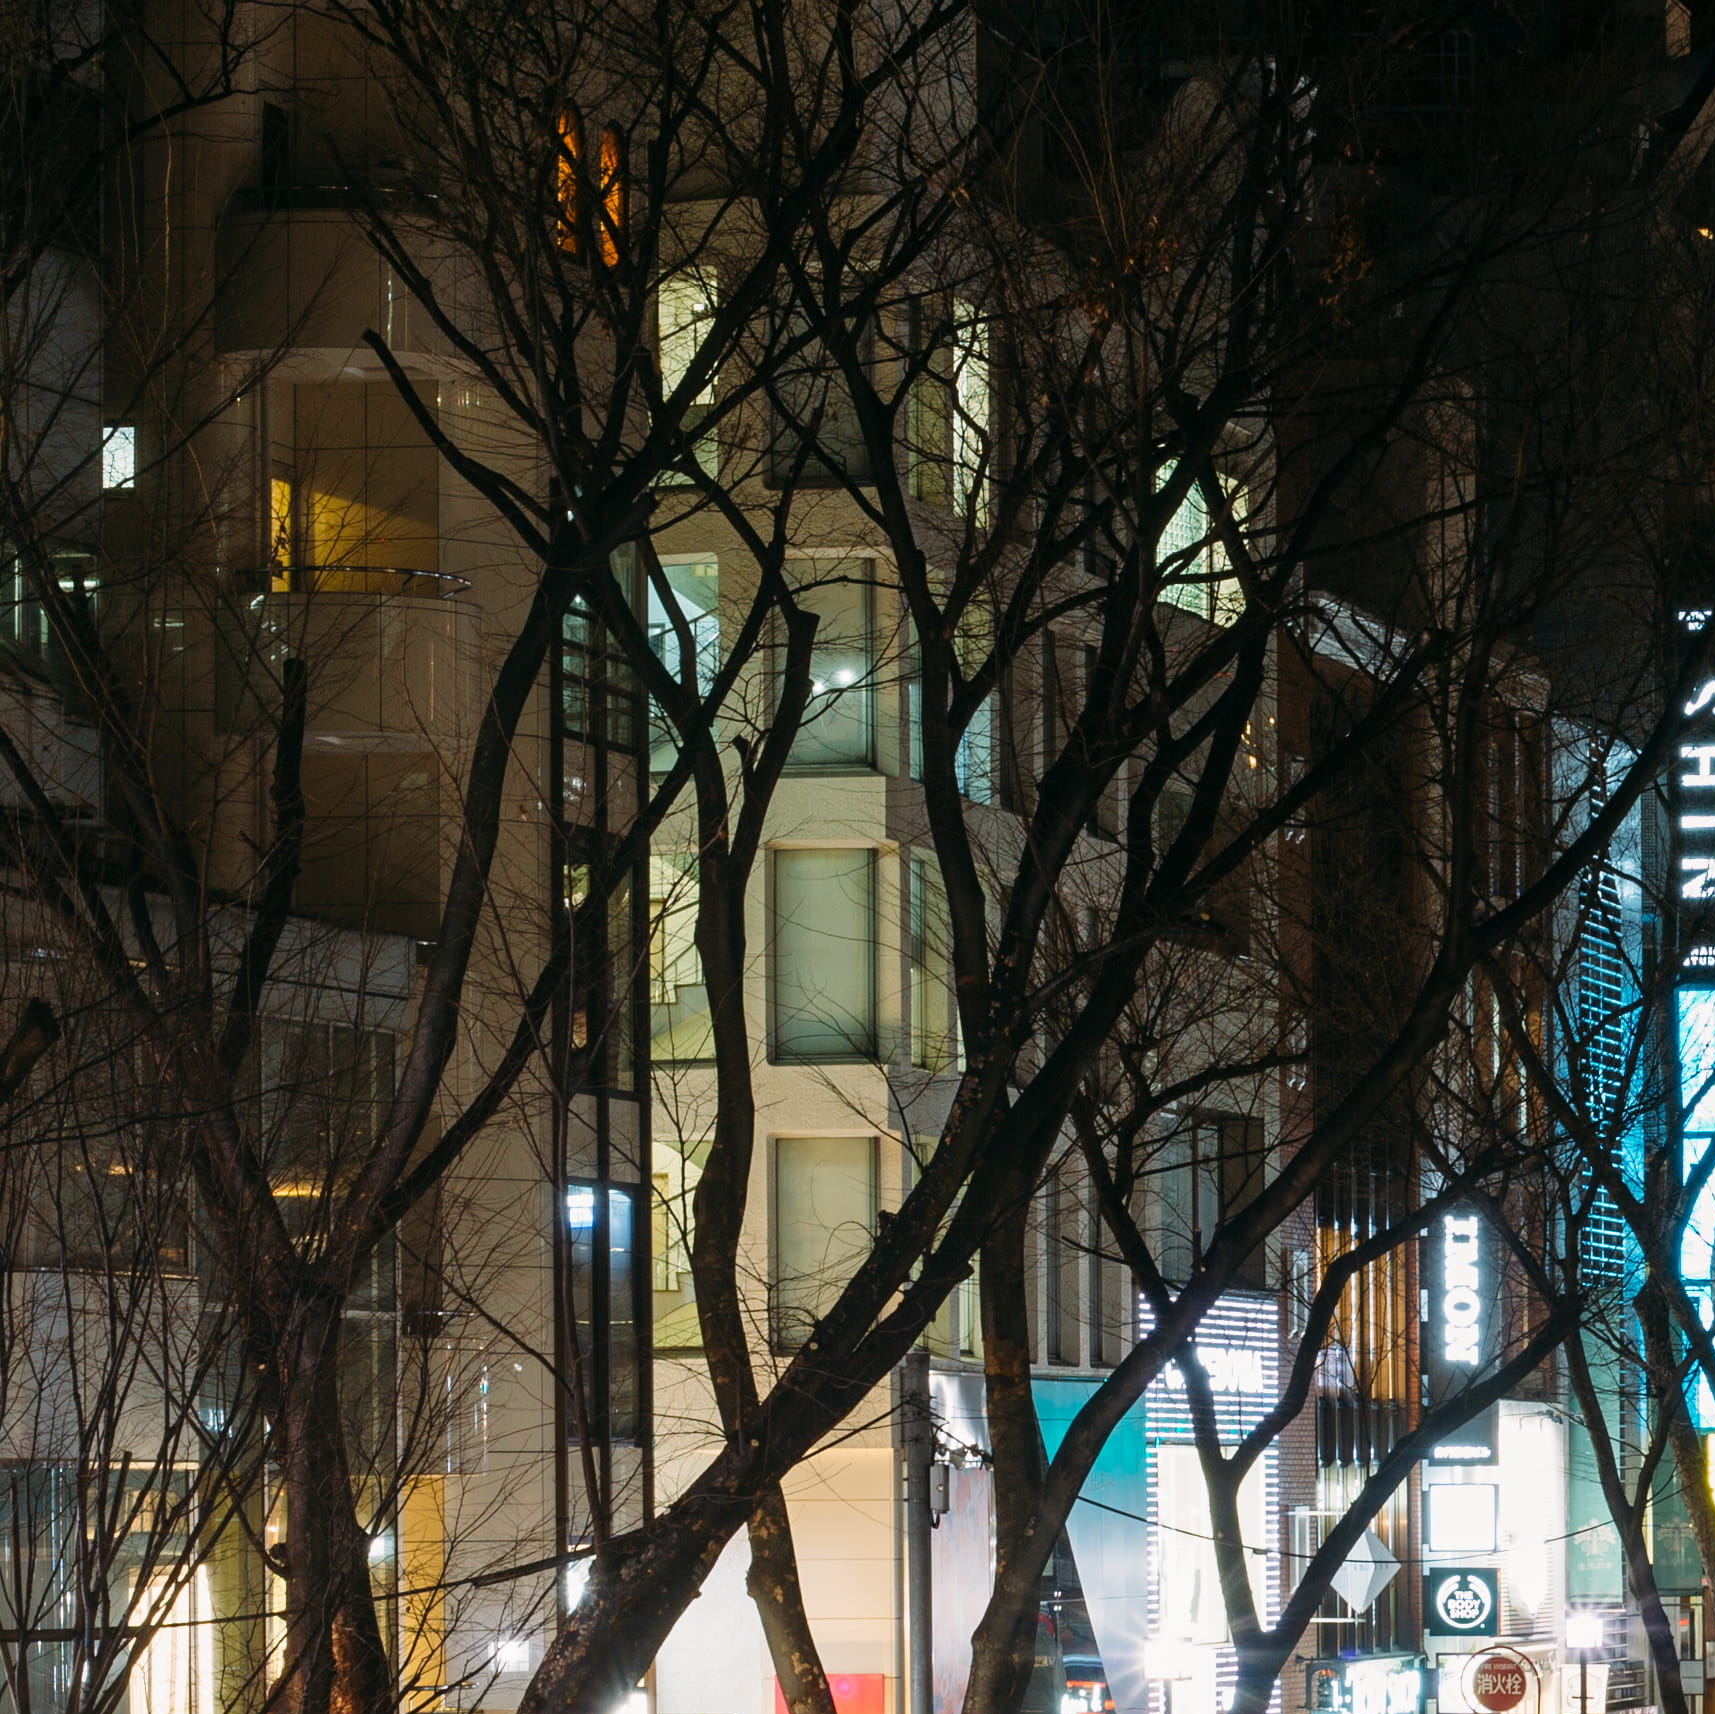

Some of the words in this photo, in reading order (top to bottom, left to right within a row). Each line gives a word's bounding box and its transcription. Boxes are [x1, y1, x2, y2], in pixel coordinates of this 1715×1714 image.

[1454, 1590, 1474, 1600] THE
[1447, 1599, 1481, 1610] BODY
[1449, 1609, 1480, 1619] SHOP
[1476, 1673, 1523, 1696] 消火栓
